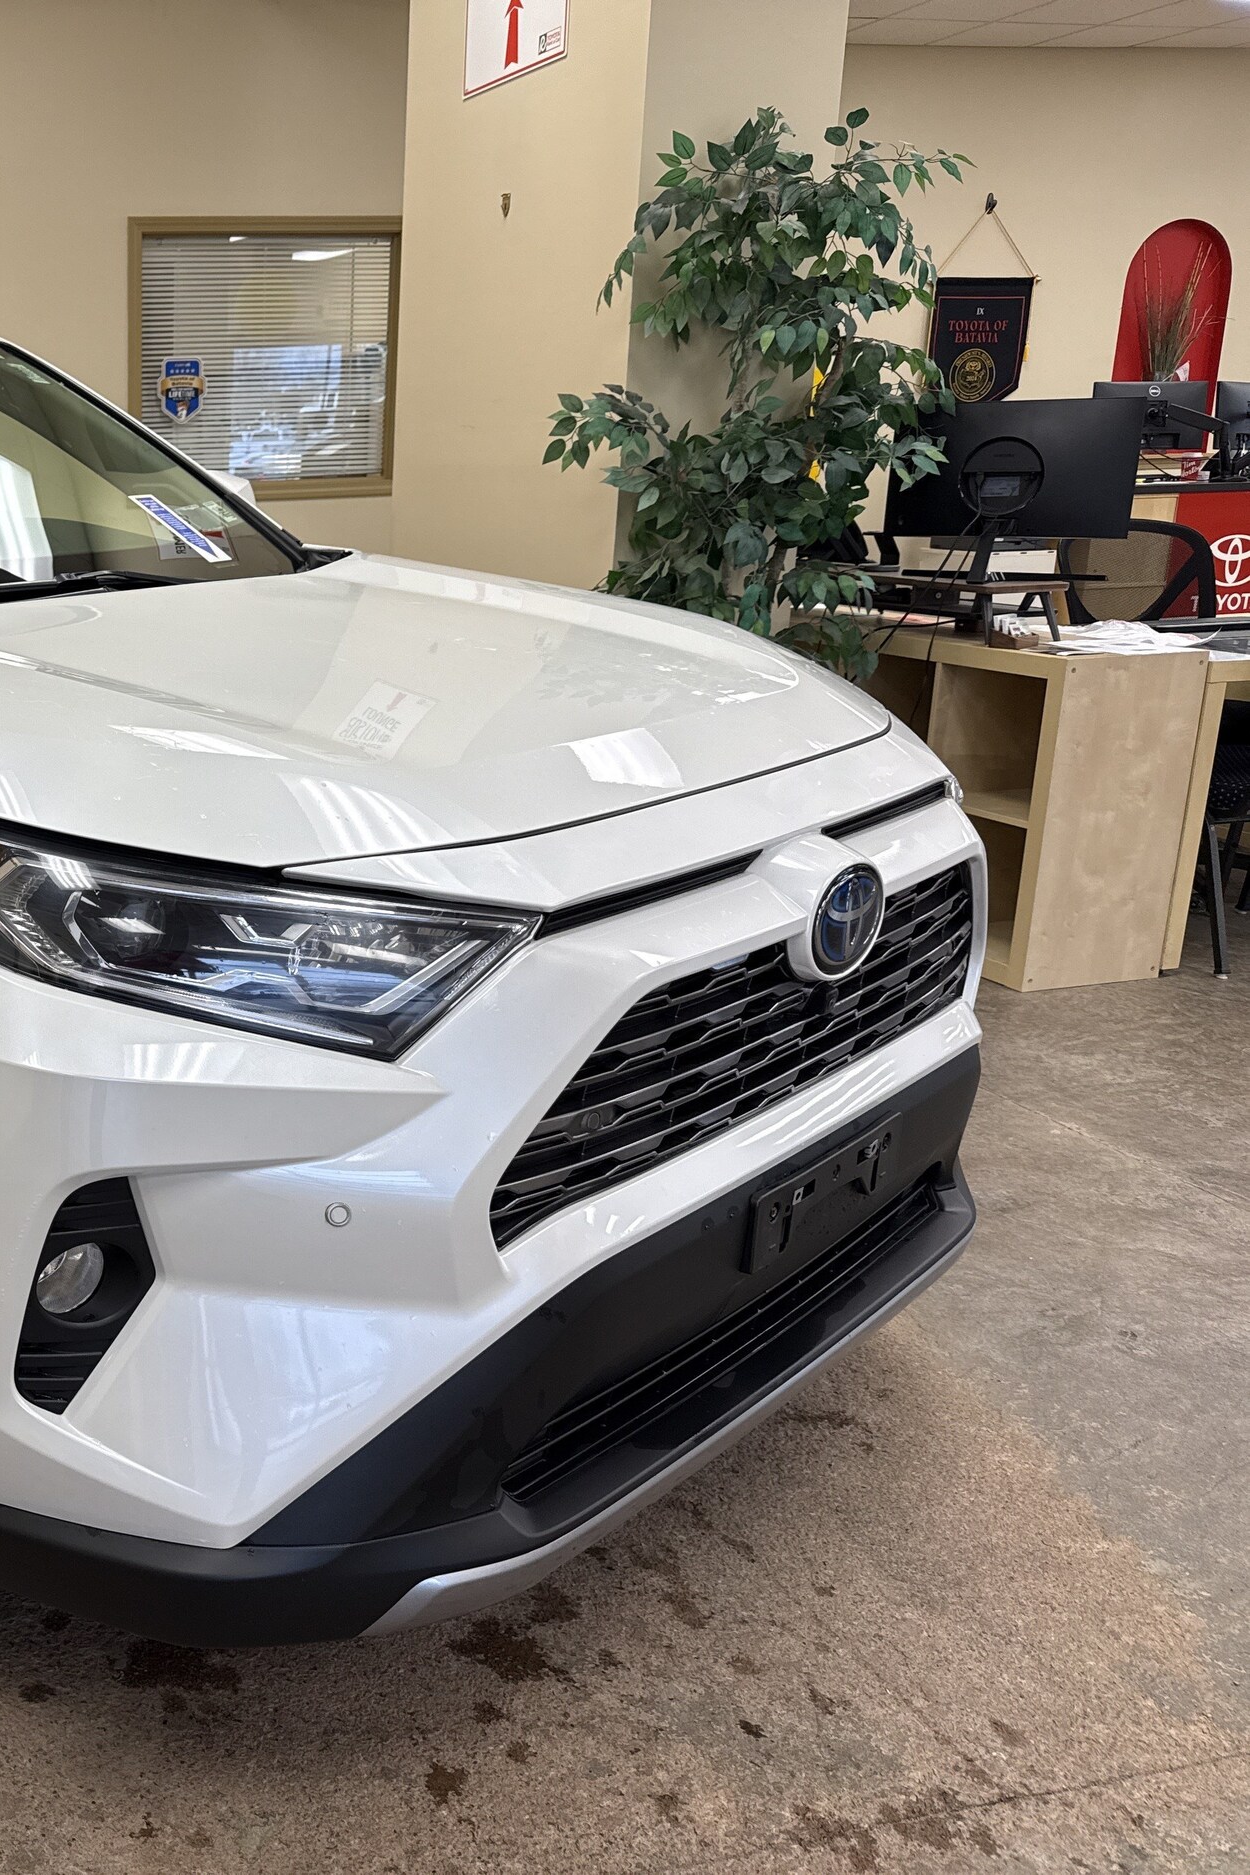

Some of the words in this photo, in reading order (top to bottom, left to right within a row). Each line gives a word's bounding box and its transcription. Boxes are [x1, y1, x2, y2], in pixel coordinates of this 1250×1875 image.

[948, 320, 990, 331] TOYOTA
[994, 320, 1009, 331] OF
[955, 332, 998, 343] BATAVIA
